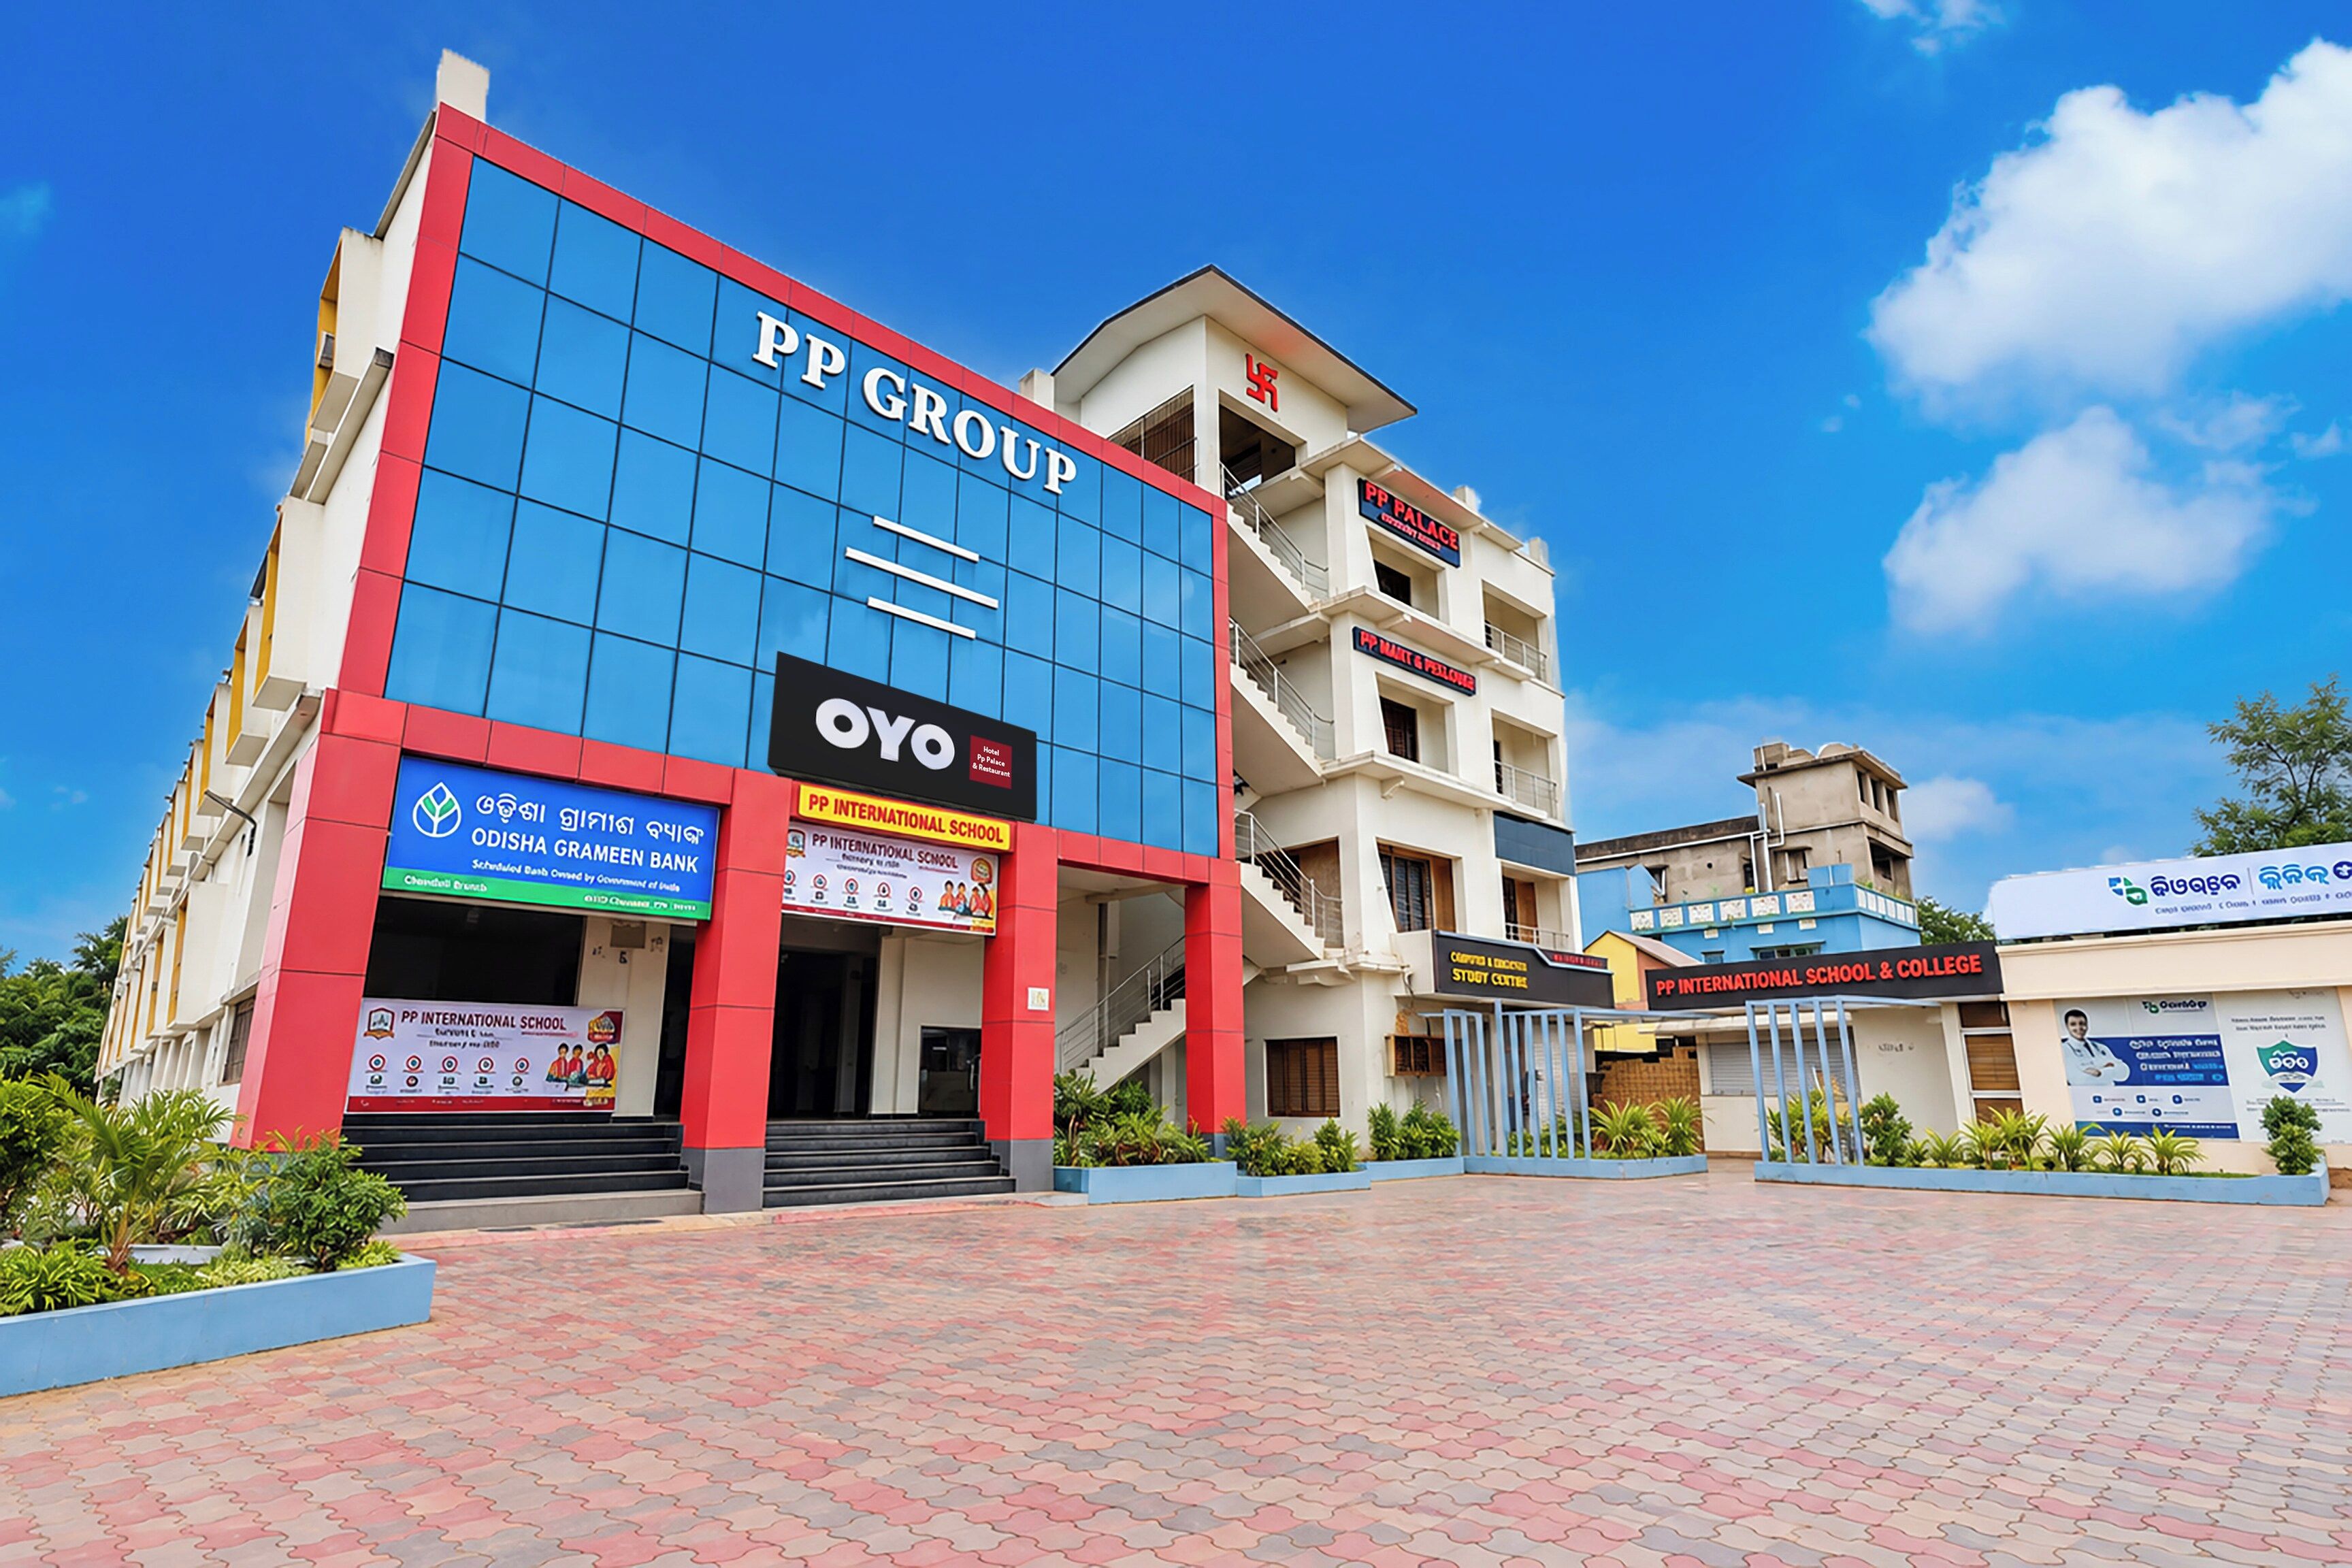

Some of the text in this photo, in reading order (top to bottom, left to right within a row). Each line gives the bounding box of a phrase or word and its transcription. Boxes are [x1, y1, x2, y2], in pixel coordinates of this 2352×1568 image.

[752, 311, 1077, 495] PP GROUP
[1365, 480, 1388, 508] PP
[1394, 498, 1458, 551] PALACE
[1360, 631, 1377, 651] PP
[816, 698, 955, 770] OYO
[983, 746, 1000, 756] Hotel
[977, 753, 1005, 767] Pp Palace
[979, 764, 1011, 777] Restaurant
[809, 794, 1004, 843] PP INTERNATIONAL SCHOOL
[472, 828, 699, 873] ODISHA GRAMEEN BANK
[813, 834, 827, 847] PP
[830, 836, 914, 861] INTERNATIONAL
[917, 851, 958, 868] SCHOOL
[584, 872, 595, 885] by
[1656, 954, 1982, 996] PP INTERNATIONAL SCHOOL & COLLEGE
[401, 1011, 566, 1030] PP INTERNATIONAL SCHOOL
